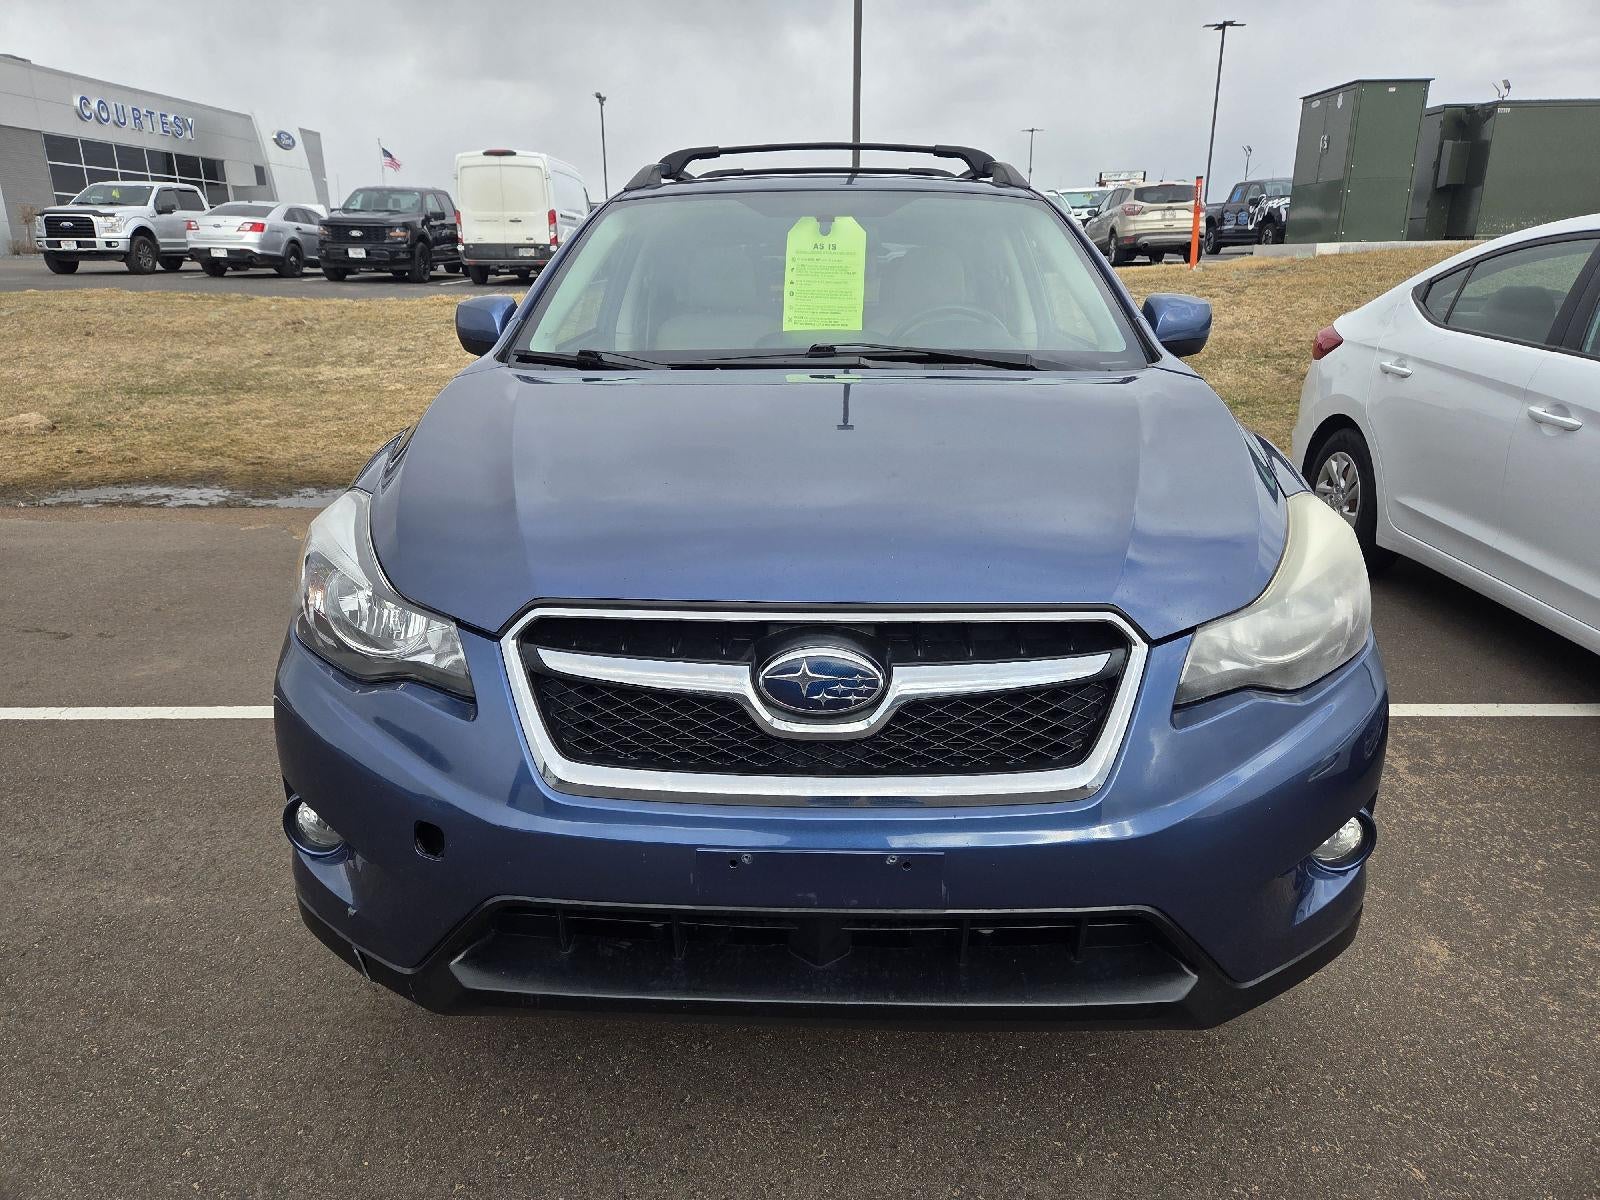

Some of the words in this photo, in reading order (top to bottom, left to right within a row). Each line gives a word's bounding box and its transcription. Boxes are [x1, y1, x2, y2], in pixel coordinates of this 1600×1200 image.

[78, 95, 195, 140] COURTESY
[812, 243, 825, 251] AS
[828, 243, 837, 251] IS
